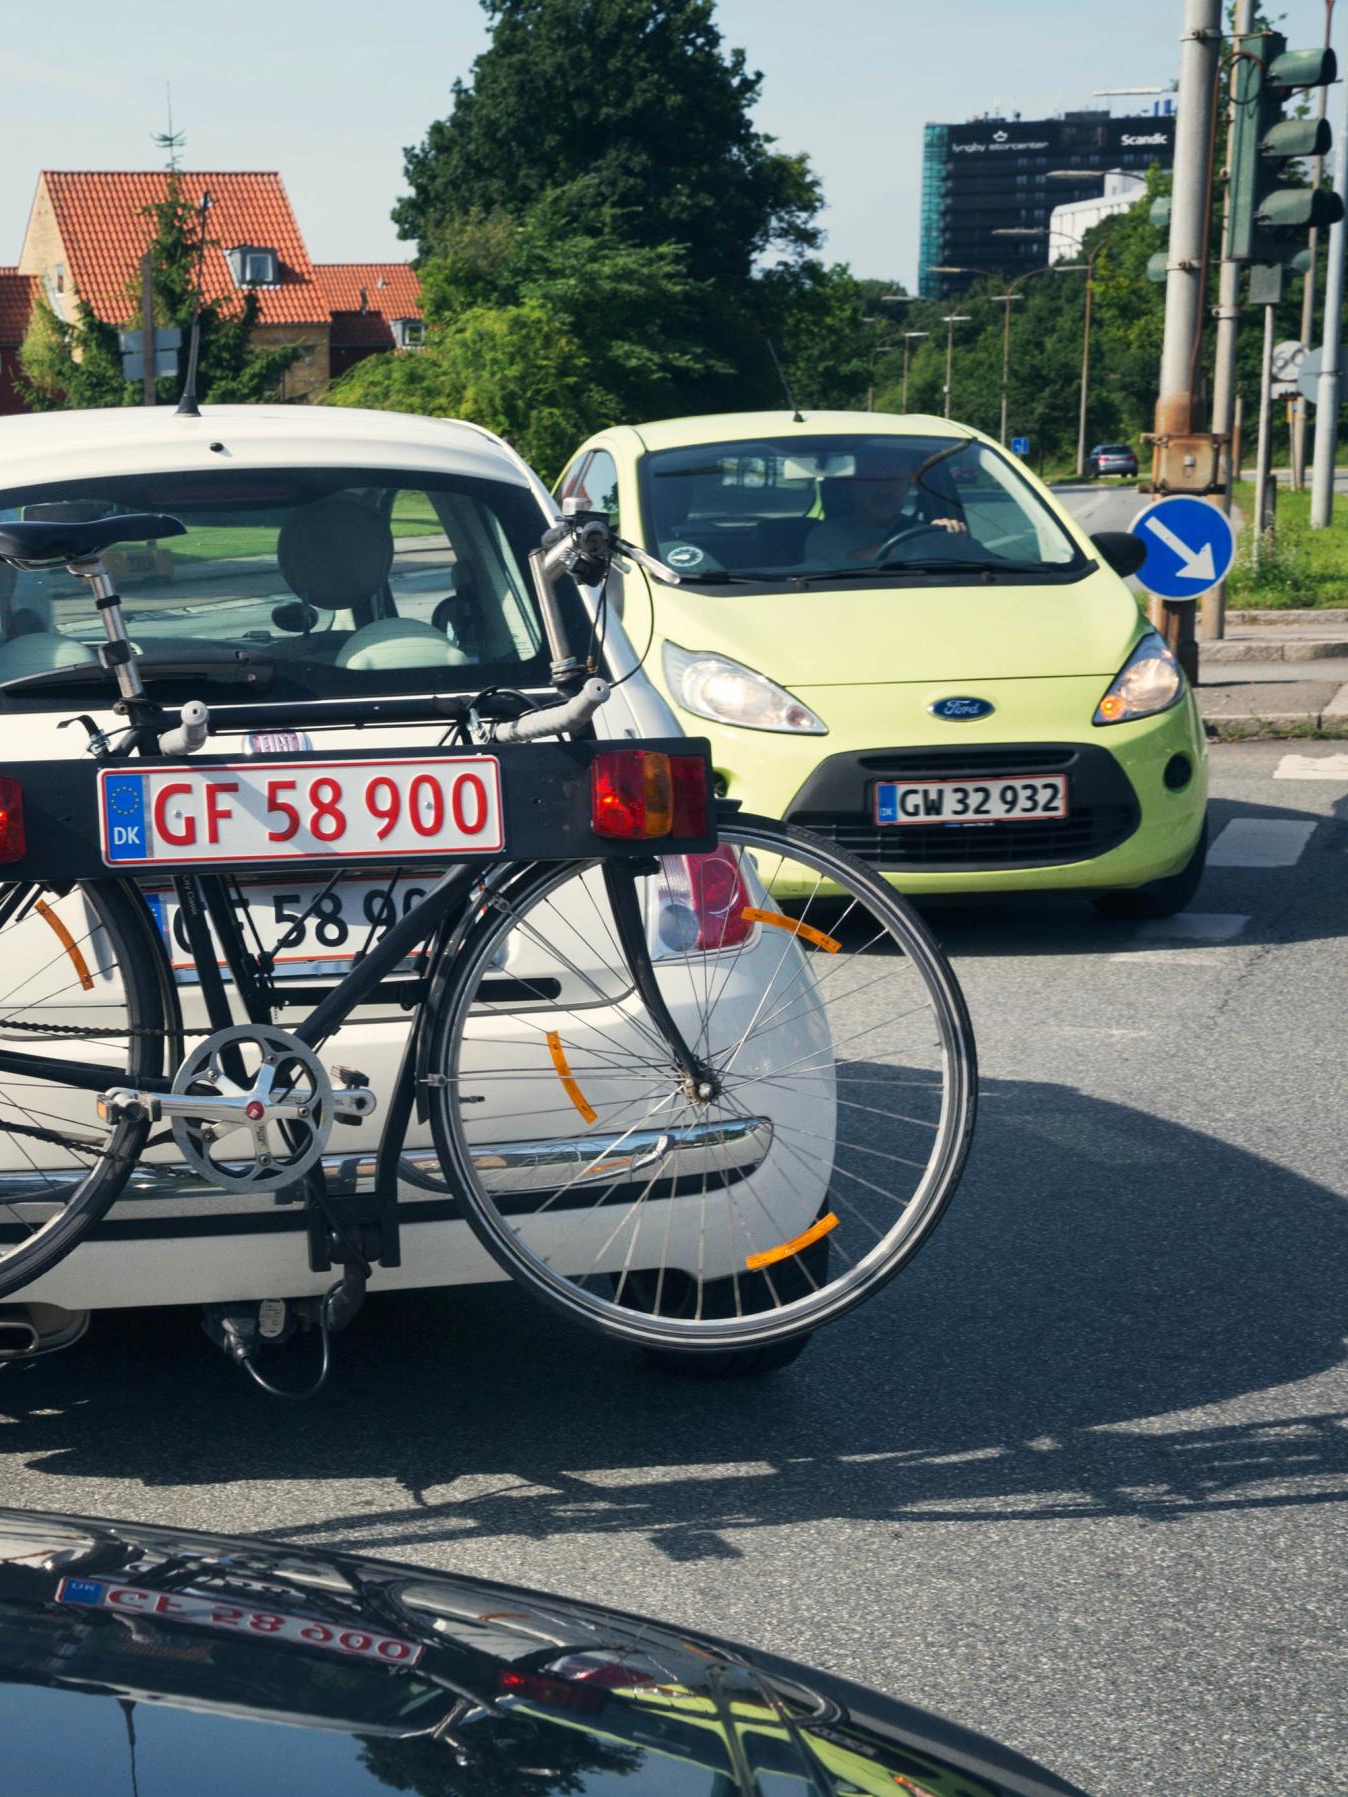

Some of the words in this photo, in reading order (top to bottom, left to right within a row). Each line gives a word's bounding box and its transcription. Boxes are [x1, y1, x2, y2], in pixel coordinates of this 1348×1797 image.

[952, 142, 986, 153] lyngby
[1121, 132, 1168, 146] Scandic
[943, 699, 980, 715] Ford
[258, 732, 297, 752] FIAT
[154, 782, 239, 847] GF
[267, 776, 347, 843] 58
[365, 772, 488, 841] 900
[899, 788, 944, 817] GW
[952, 786, 991, 816] 32
[999, 782, 1061, 815] 932
[113, 825, 141, 846] DK
[273, 892, 349, 948] 58
